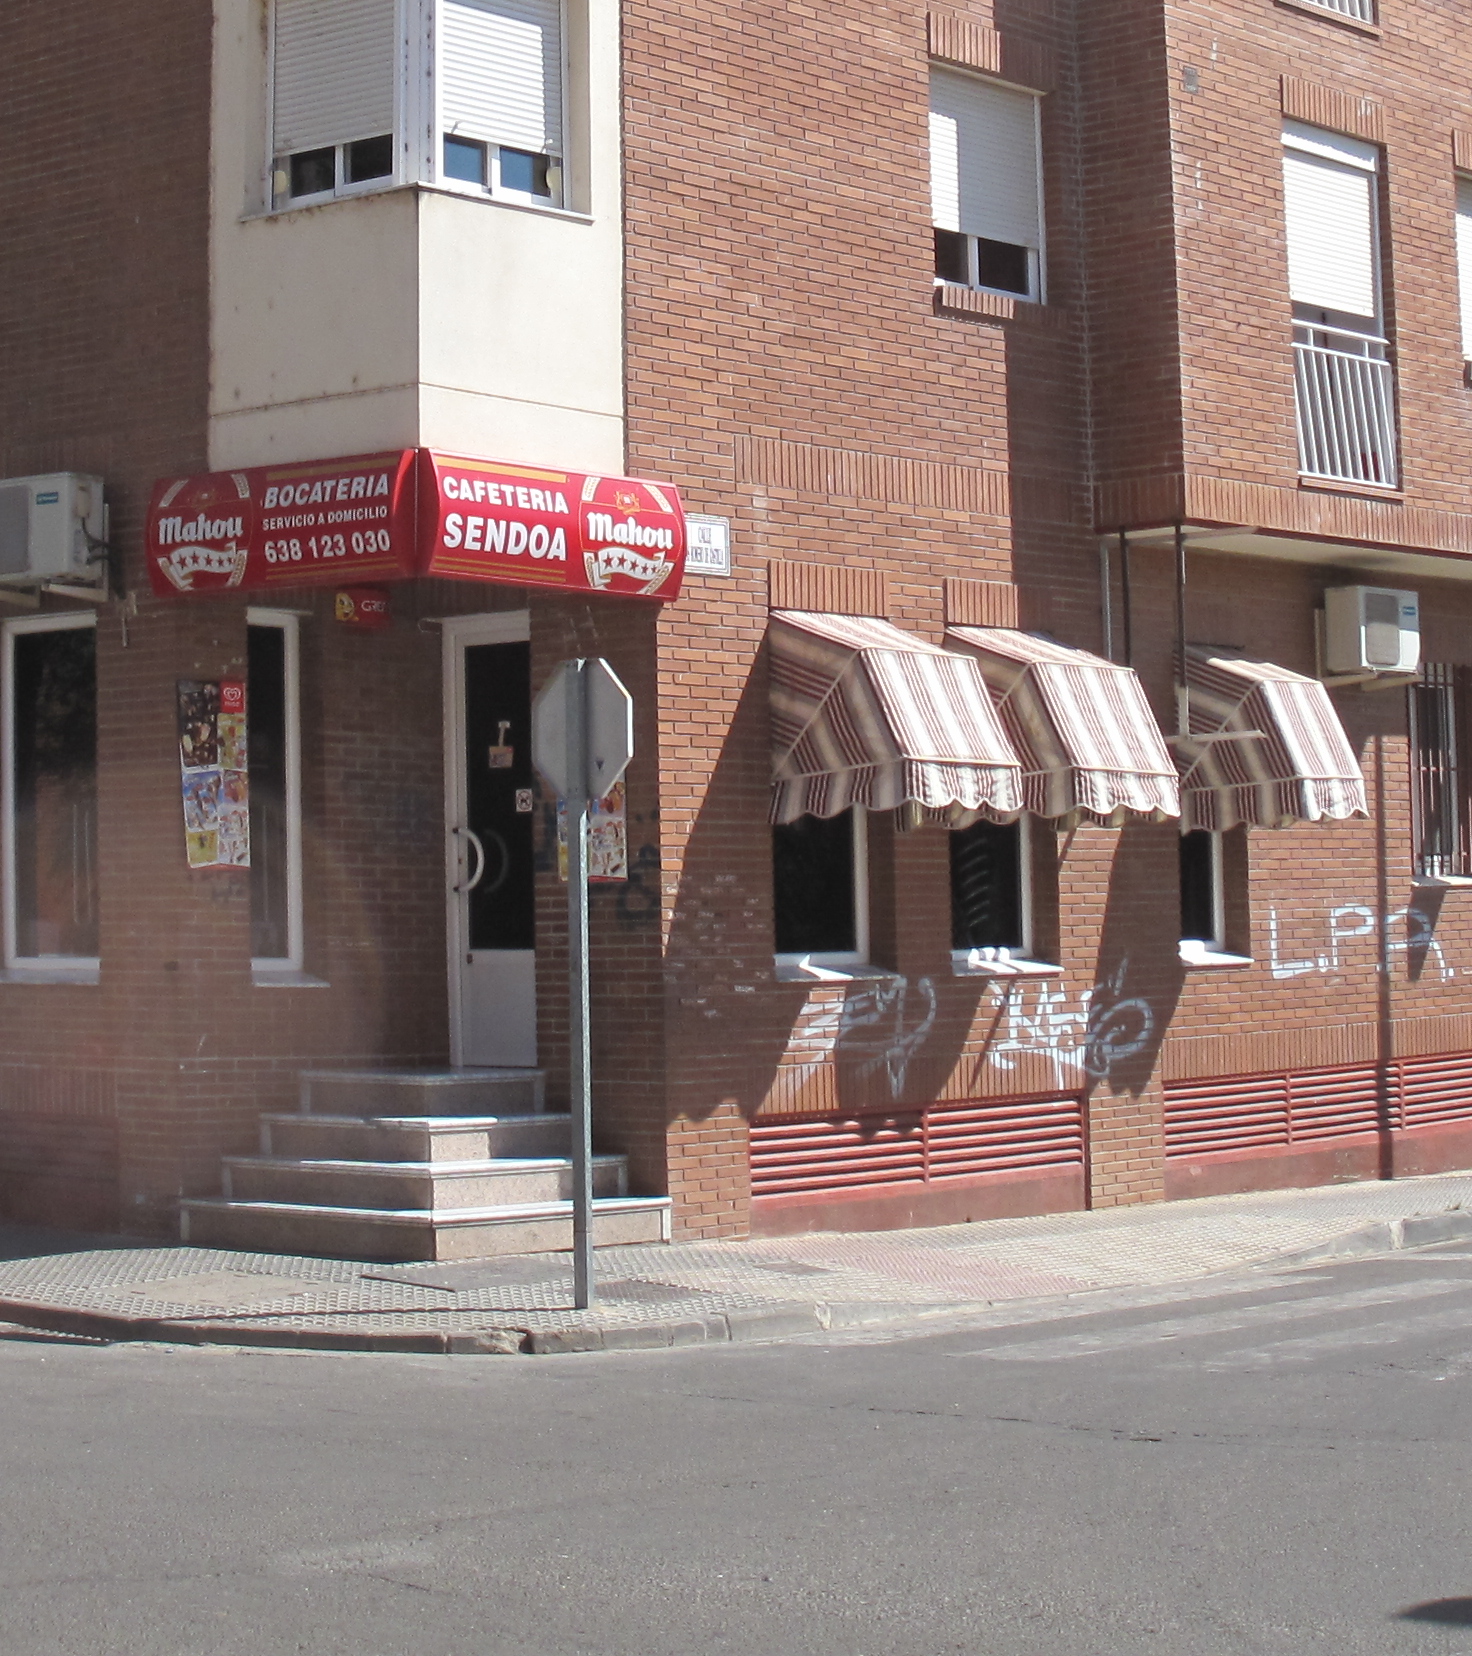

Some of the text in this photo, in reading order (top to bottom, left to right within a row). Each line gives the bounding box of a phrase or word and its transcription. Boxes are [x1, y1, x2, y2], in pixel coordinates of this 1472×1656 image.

[263, 473, 389, 509] BOCATERIA
[442, 475, 570, 514] CAFETERIA
[158, 512, 244, 545] Mahou
[262, 505, 388, 531] SERVICIO A DOMICILIO
[586, 511, 674, 550] Mahou
[264, 529, 391, 564] 638 123 030
[443, 512, 567, 562] SENDOA
